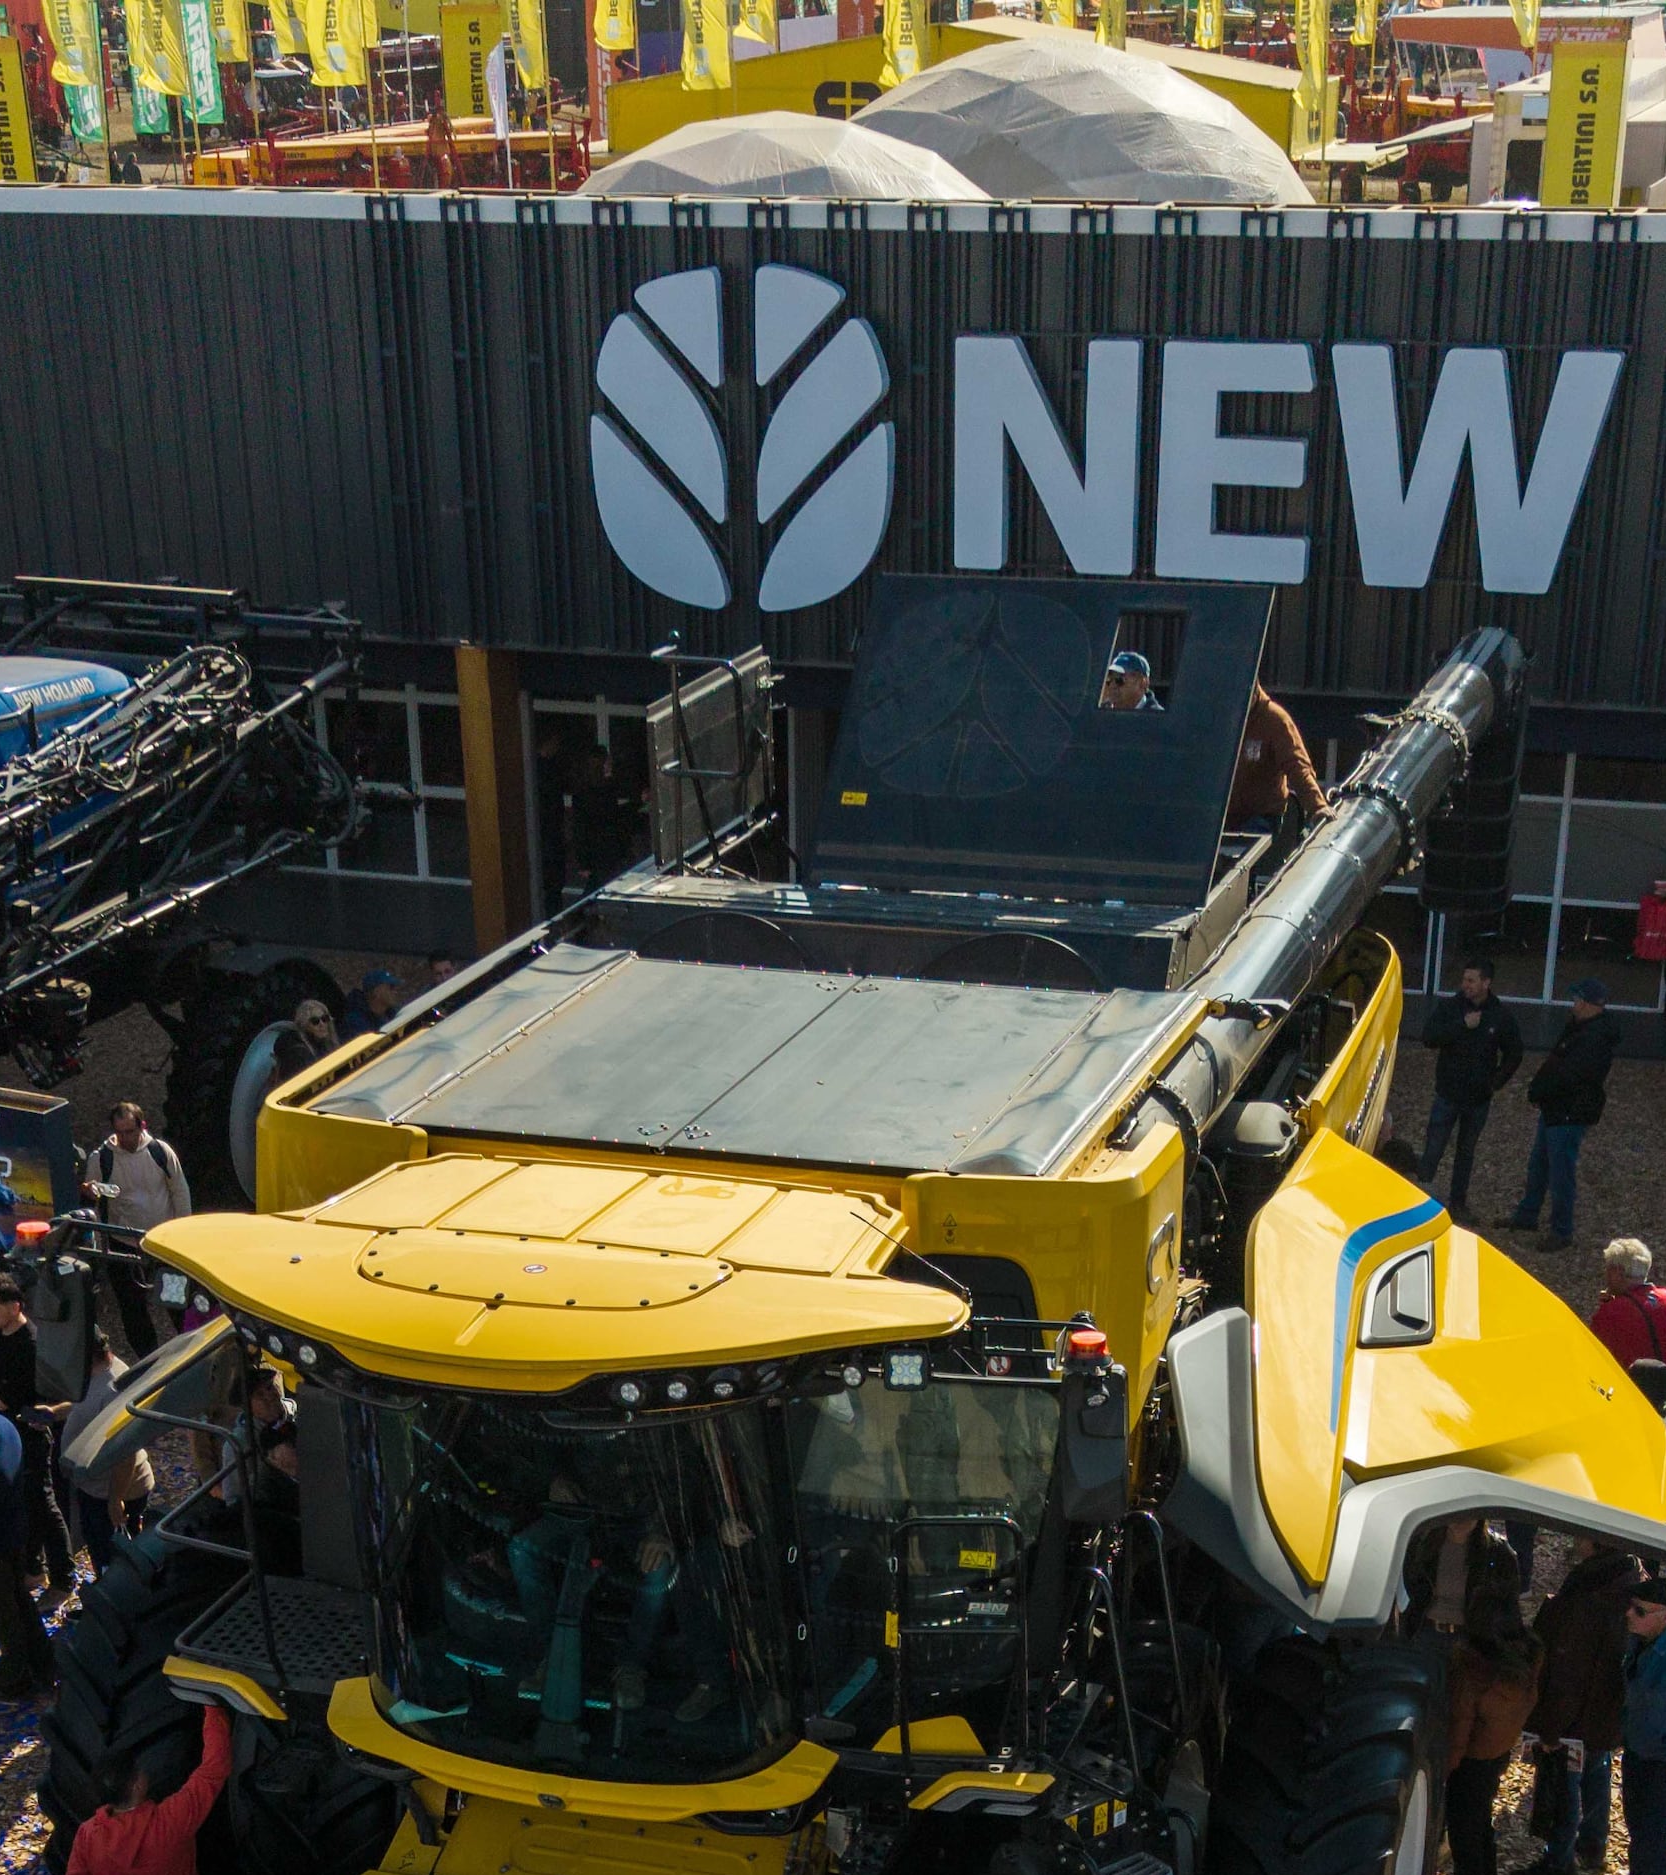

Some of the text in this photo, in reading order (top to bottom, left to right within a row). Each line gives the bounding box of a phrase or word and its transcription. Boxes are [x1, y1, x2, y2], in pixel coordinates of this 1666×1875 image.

[470, 57, 484, 114] BERTINI
[1570, 117, 1596, 205] BERTINI
[952, 335, 1624, 595] NEW
[12, 677, 95, 708] NEW HOLLAND
